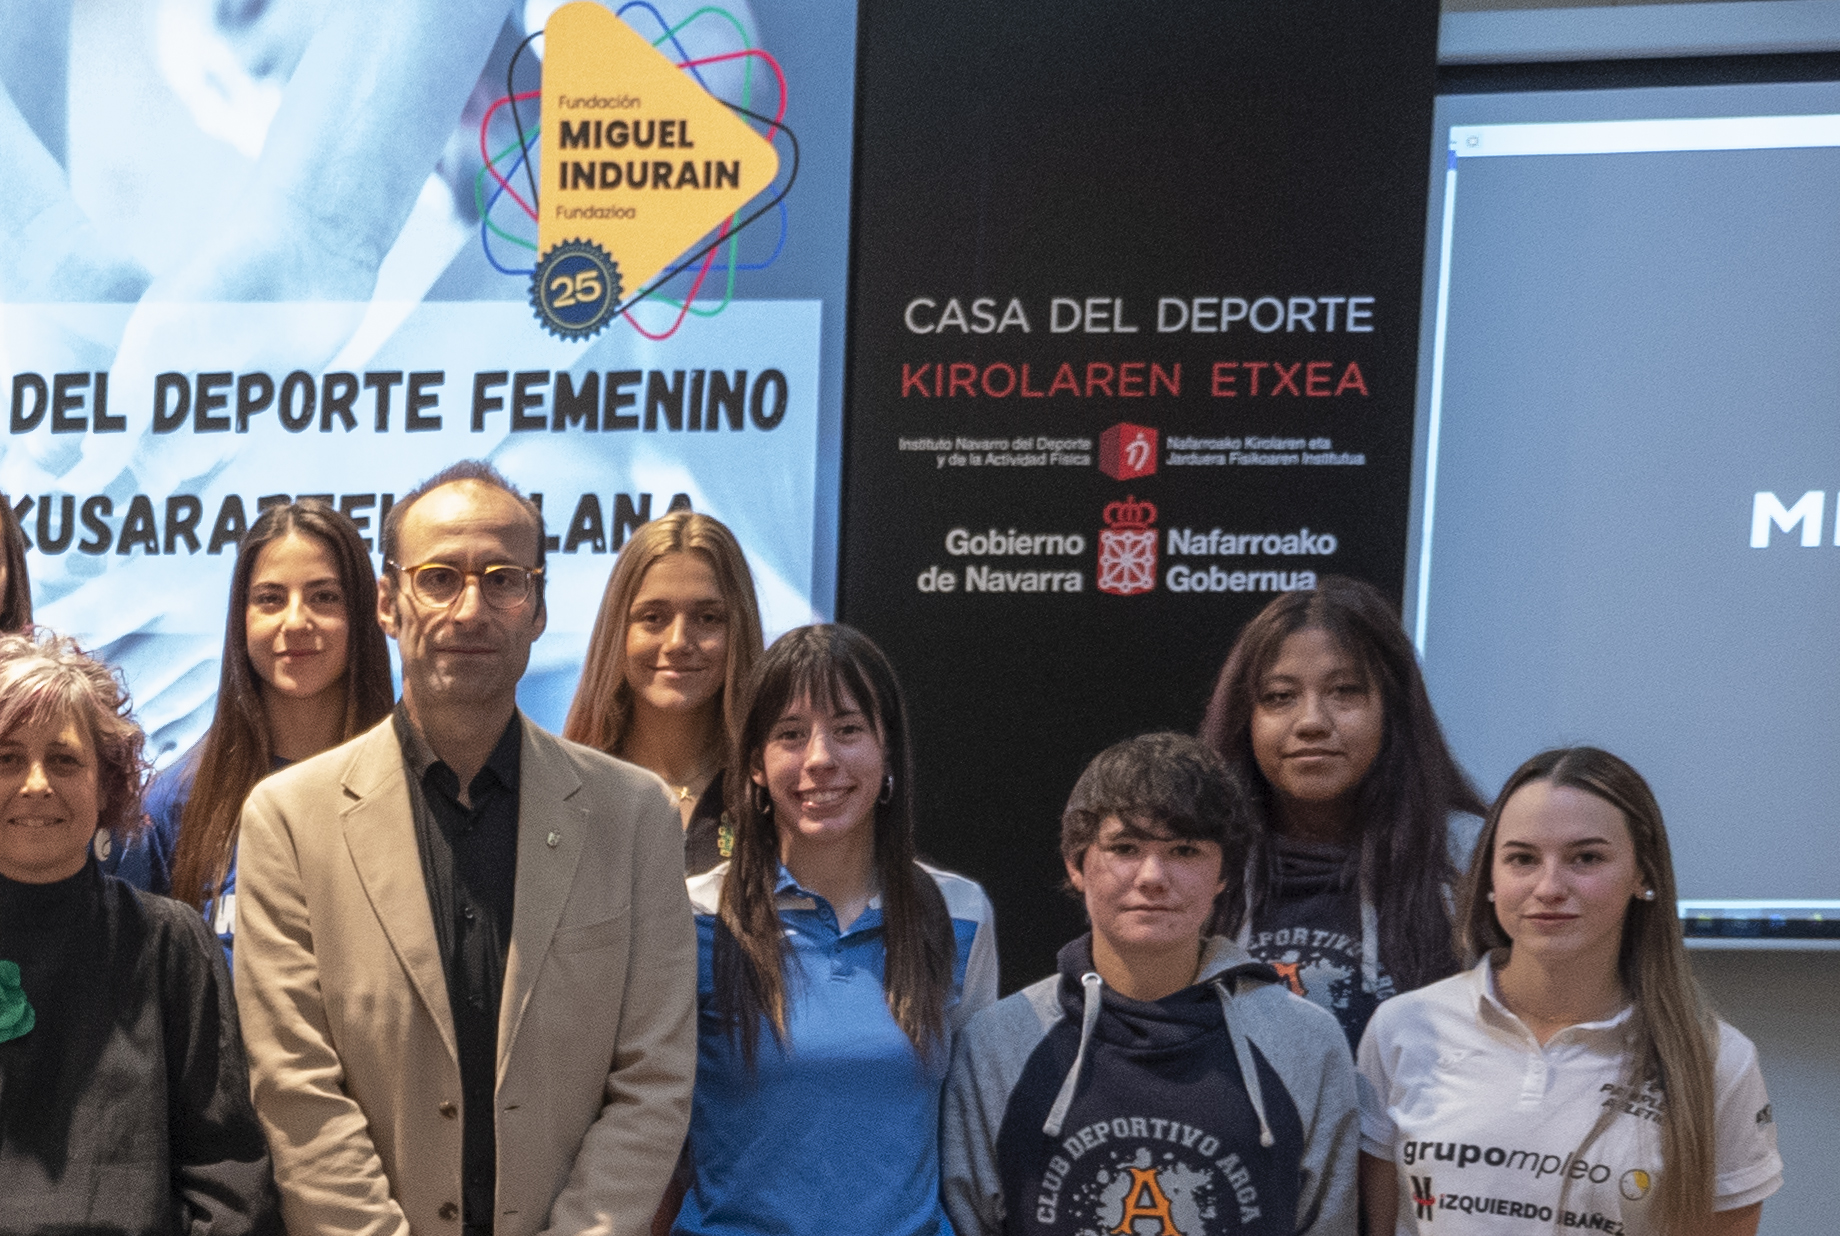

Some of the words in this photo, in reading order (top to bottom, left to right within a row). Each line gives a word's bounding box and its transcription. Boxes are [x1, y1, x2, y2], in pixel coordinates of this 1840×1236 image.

[558, 93, 641, 110] Fundación
[559, 119, 695, 150] MIGUEL
[559, 160, 741, 190] INDURAIN
[556, 205, 637, 220] Fundazioa
[551, 269, 603, 308] 25
[904, 298, 1031, 334] CASA
[1050, 298, 1138, 333] DEL
[1156, 296, 1376, 332] DEPORTE
[900, 361, 1182, 399] KIROLAREN
[1211, 360, 1370, 397] ETXEA
[9, 371, 127, 435] DEL
[150, 369, 445, 434] DEPORTE
[469, 367, 790, 434] FEMENINO
[898, 437, 953, 451] Instituto
[955, 437, 1010, 451] Navarro
[1011, 437, 1034, 451] del
[1036, 437, 1092, 453] Deporte
[935, 454, 947, 469] y
[947, 453, 968, 467] de
[969, 453, 982, 466] la
[984, 453, 1048, 467] Actividad
[944, 527, 1085, 556] Gobierno
[1166, 527, 1338, 556] Nafarroako
[916, 564, 957, 593] de
[964, 564, 1084, 593] Navarra
[1165, 564, 1318, 593] Gobernua
[1036, 1154, 1071, 1225] CLUB
[1063, 1116, 1221, 1160] DEPORTIVO
[1215, 1152, 1261, 1225] ARGA
[1403, 1140, 1612, 1184] grupompleo
